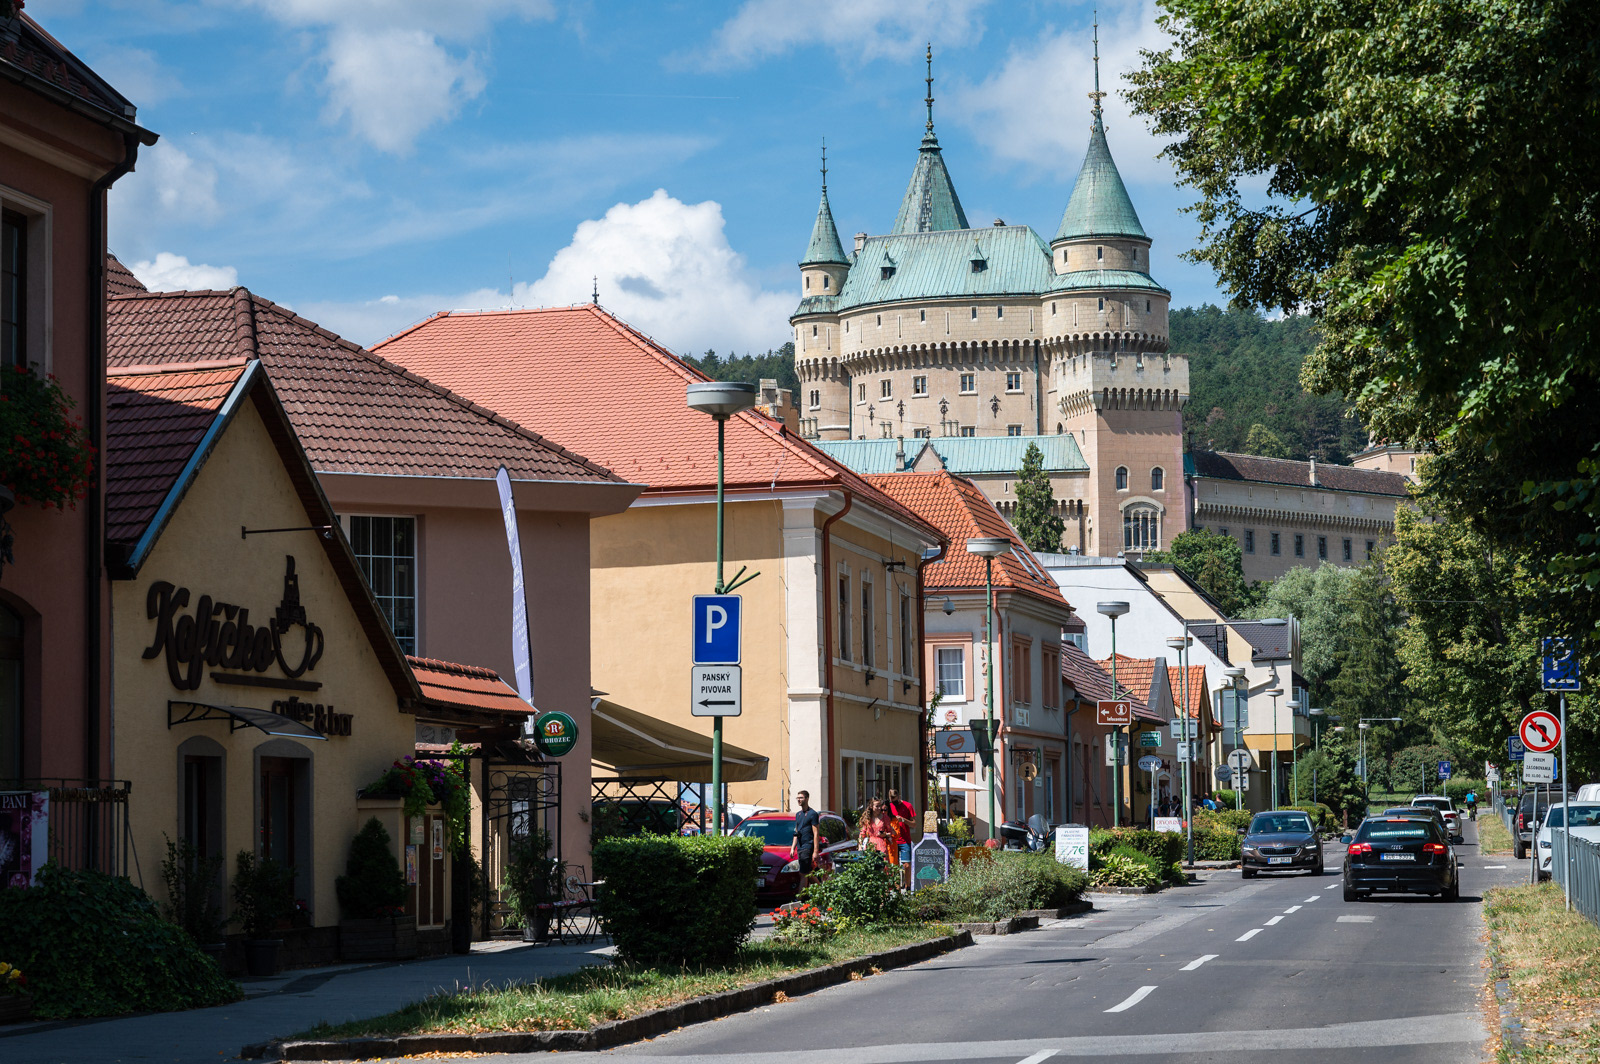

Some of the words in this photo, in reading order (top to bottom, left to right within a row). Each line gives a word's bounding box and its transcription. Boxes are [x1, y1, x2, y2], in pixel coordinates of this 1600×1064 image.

[705, 604, 727, 644] P
[701, 671, 731, 682] PANSKÝ
[700, 685, 732, 694] PIVOVAR
[550, 724, 558, 733] R
[2, 795, 27, 808] PANI
[1072, 845, 1085, 855] 7€
